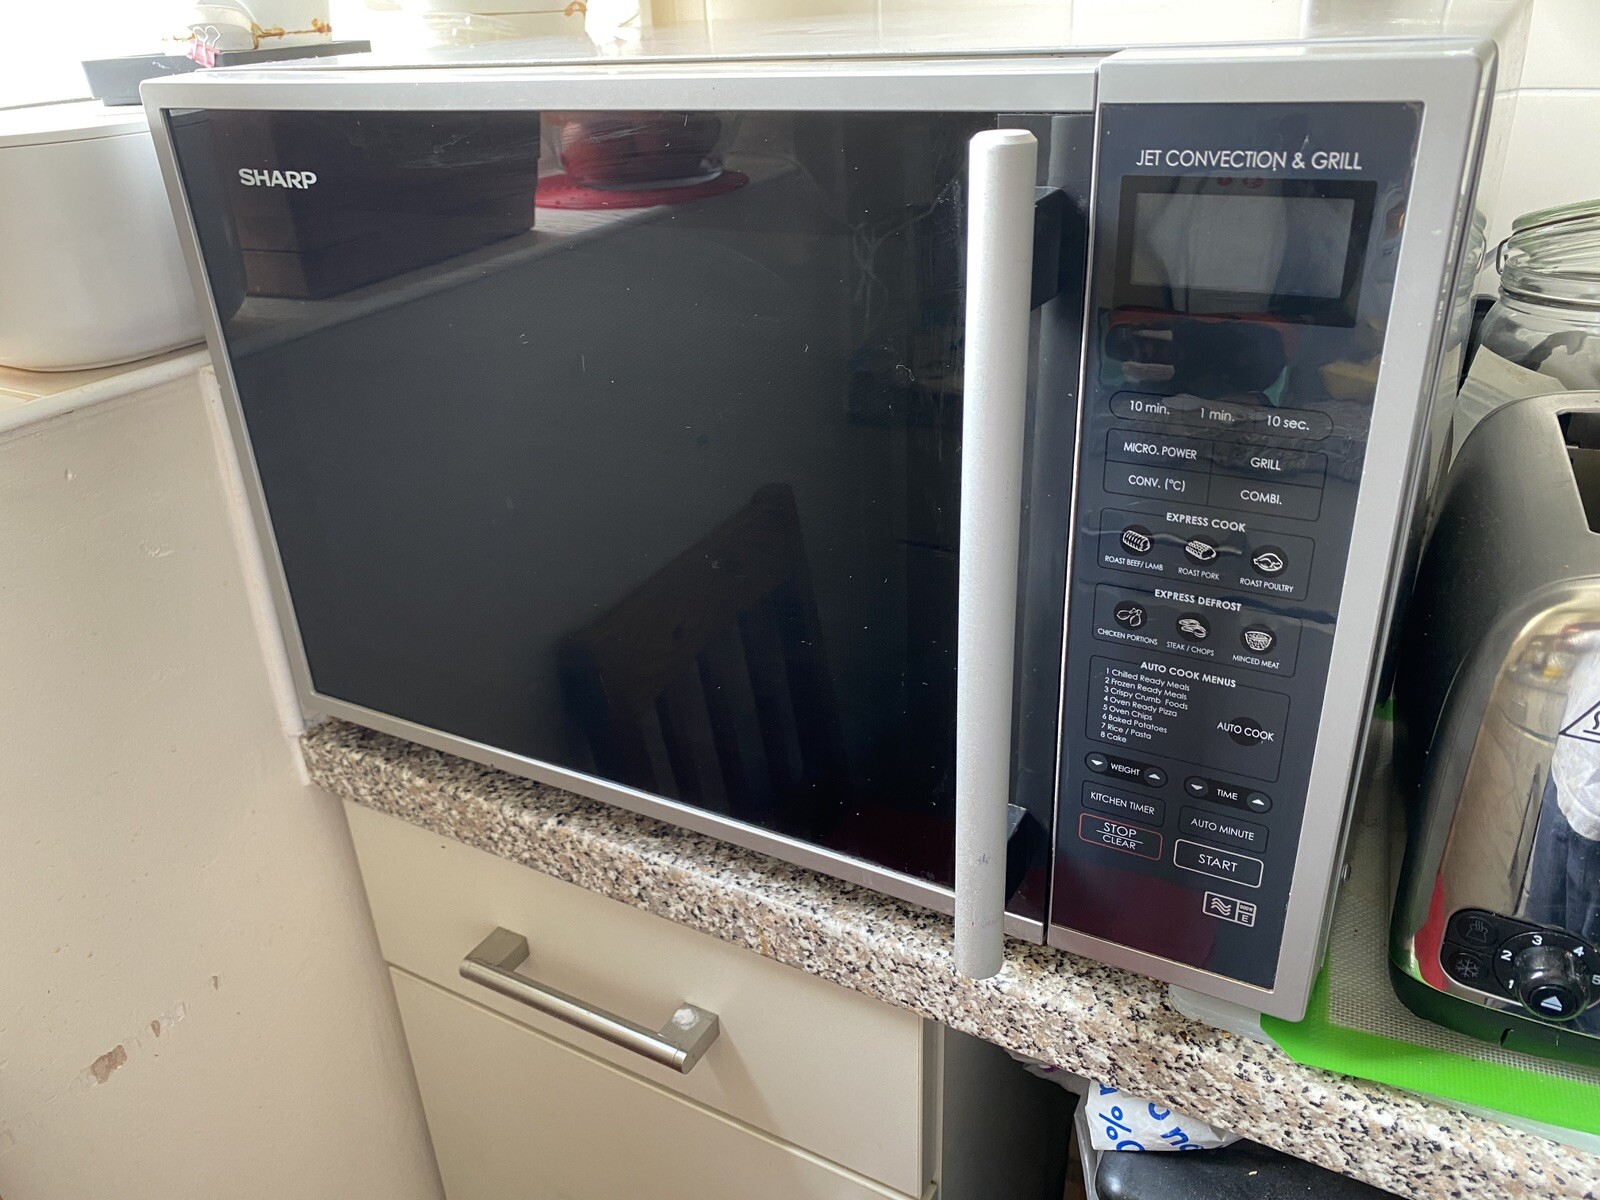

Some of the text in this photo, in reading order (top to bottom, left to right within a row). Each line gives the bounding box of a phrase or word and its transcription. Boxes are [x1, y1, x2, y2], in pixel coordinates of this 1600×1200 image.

[1136, 150, 1362, 170] JET CONVECTION & GRILL
[238, 168, 317, 189] SHARP
[1129, 400, 1170, 415] 10 min.
[1200, 408, 1235, 422] 1 min.
[1267, 415, 1310, 431] 10 sec.
[1123, 442, 1197, 460] MICRO. POWER
[1250, 457, 1281, 471] GRILL
[1128, 474, 1161, 489] CONV.
[1240, 489, 1282, 505] COMBI.
[1166, 512, 1246, 533] EXPRESS COOK
[1105, 555, 1126, 565] ROAST
[1144, 562, 1164, 572] LAMB
[1178, 567, 1220, 581] ROAST PORK
[1240, 577, 1294, 593] ROAST POULTRY
[1154, 589, 1242, 612] EXPRESS DEFROST
[1097, 628, 1158, 646] CHICKEN PORTIONS
[1166, 641, 1186, 651] STEAK
[1191, 646, 1215, 657] CHOPS
[1232, 654, 1280, 669] MINCED MEAT
[1111, 669, 1138, 681] Chilled
[1140, 674, 1165, 687] Ready
[1167, 681, 1190, 692] Meals
[1140, 661, 1236, 688] AUTO COOK MENUS
[1104, 676, 1187, 701] 2 Frozen Ready Meals
[1103, 685, 1188, 710] 3 Crispy Crumb Foods
[1102, 703, 1153, 721] 5 Oven Chips
[1109, 696, 1131, 707] Oven
[1132, 701, 1157, 713] Ready
[1158, 707, 1178, 718] Pizza
[1107, 723, 1124, 734] Rice
[1130, 729, 1152, 740] Pasta
[1108, 714, 1132, 726] Baked
[1133, 719, 1168, 734] Potatoes
[1216, 722, 1275, 742] AUTO COOK
[1106, 732, 1127, 743] Cake
[1110, 762, 1141, 776] WEIGHT
[1217, 788, 1238, 800] TIME
[1090, 791, 1155, 815] KITCHEN TIMER
[1103, 822, 1137, 838] STOP
[1190, 818, 1255, 841] AUTO MINUTE
[1102, 834, 1136, 850] CLEAR
[1198, 853, 1238, 872] START
[1241, 914, 1249, 923] E
[1532, 935, 1543, 945] 3
[1501, 949, 1512, 961] 2
[1573, 946, 1585, 957] 4
[1508, 979, 1515, 989] 1
